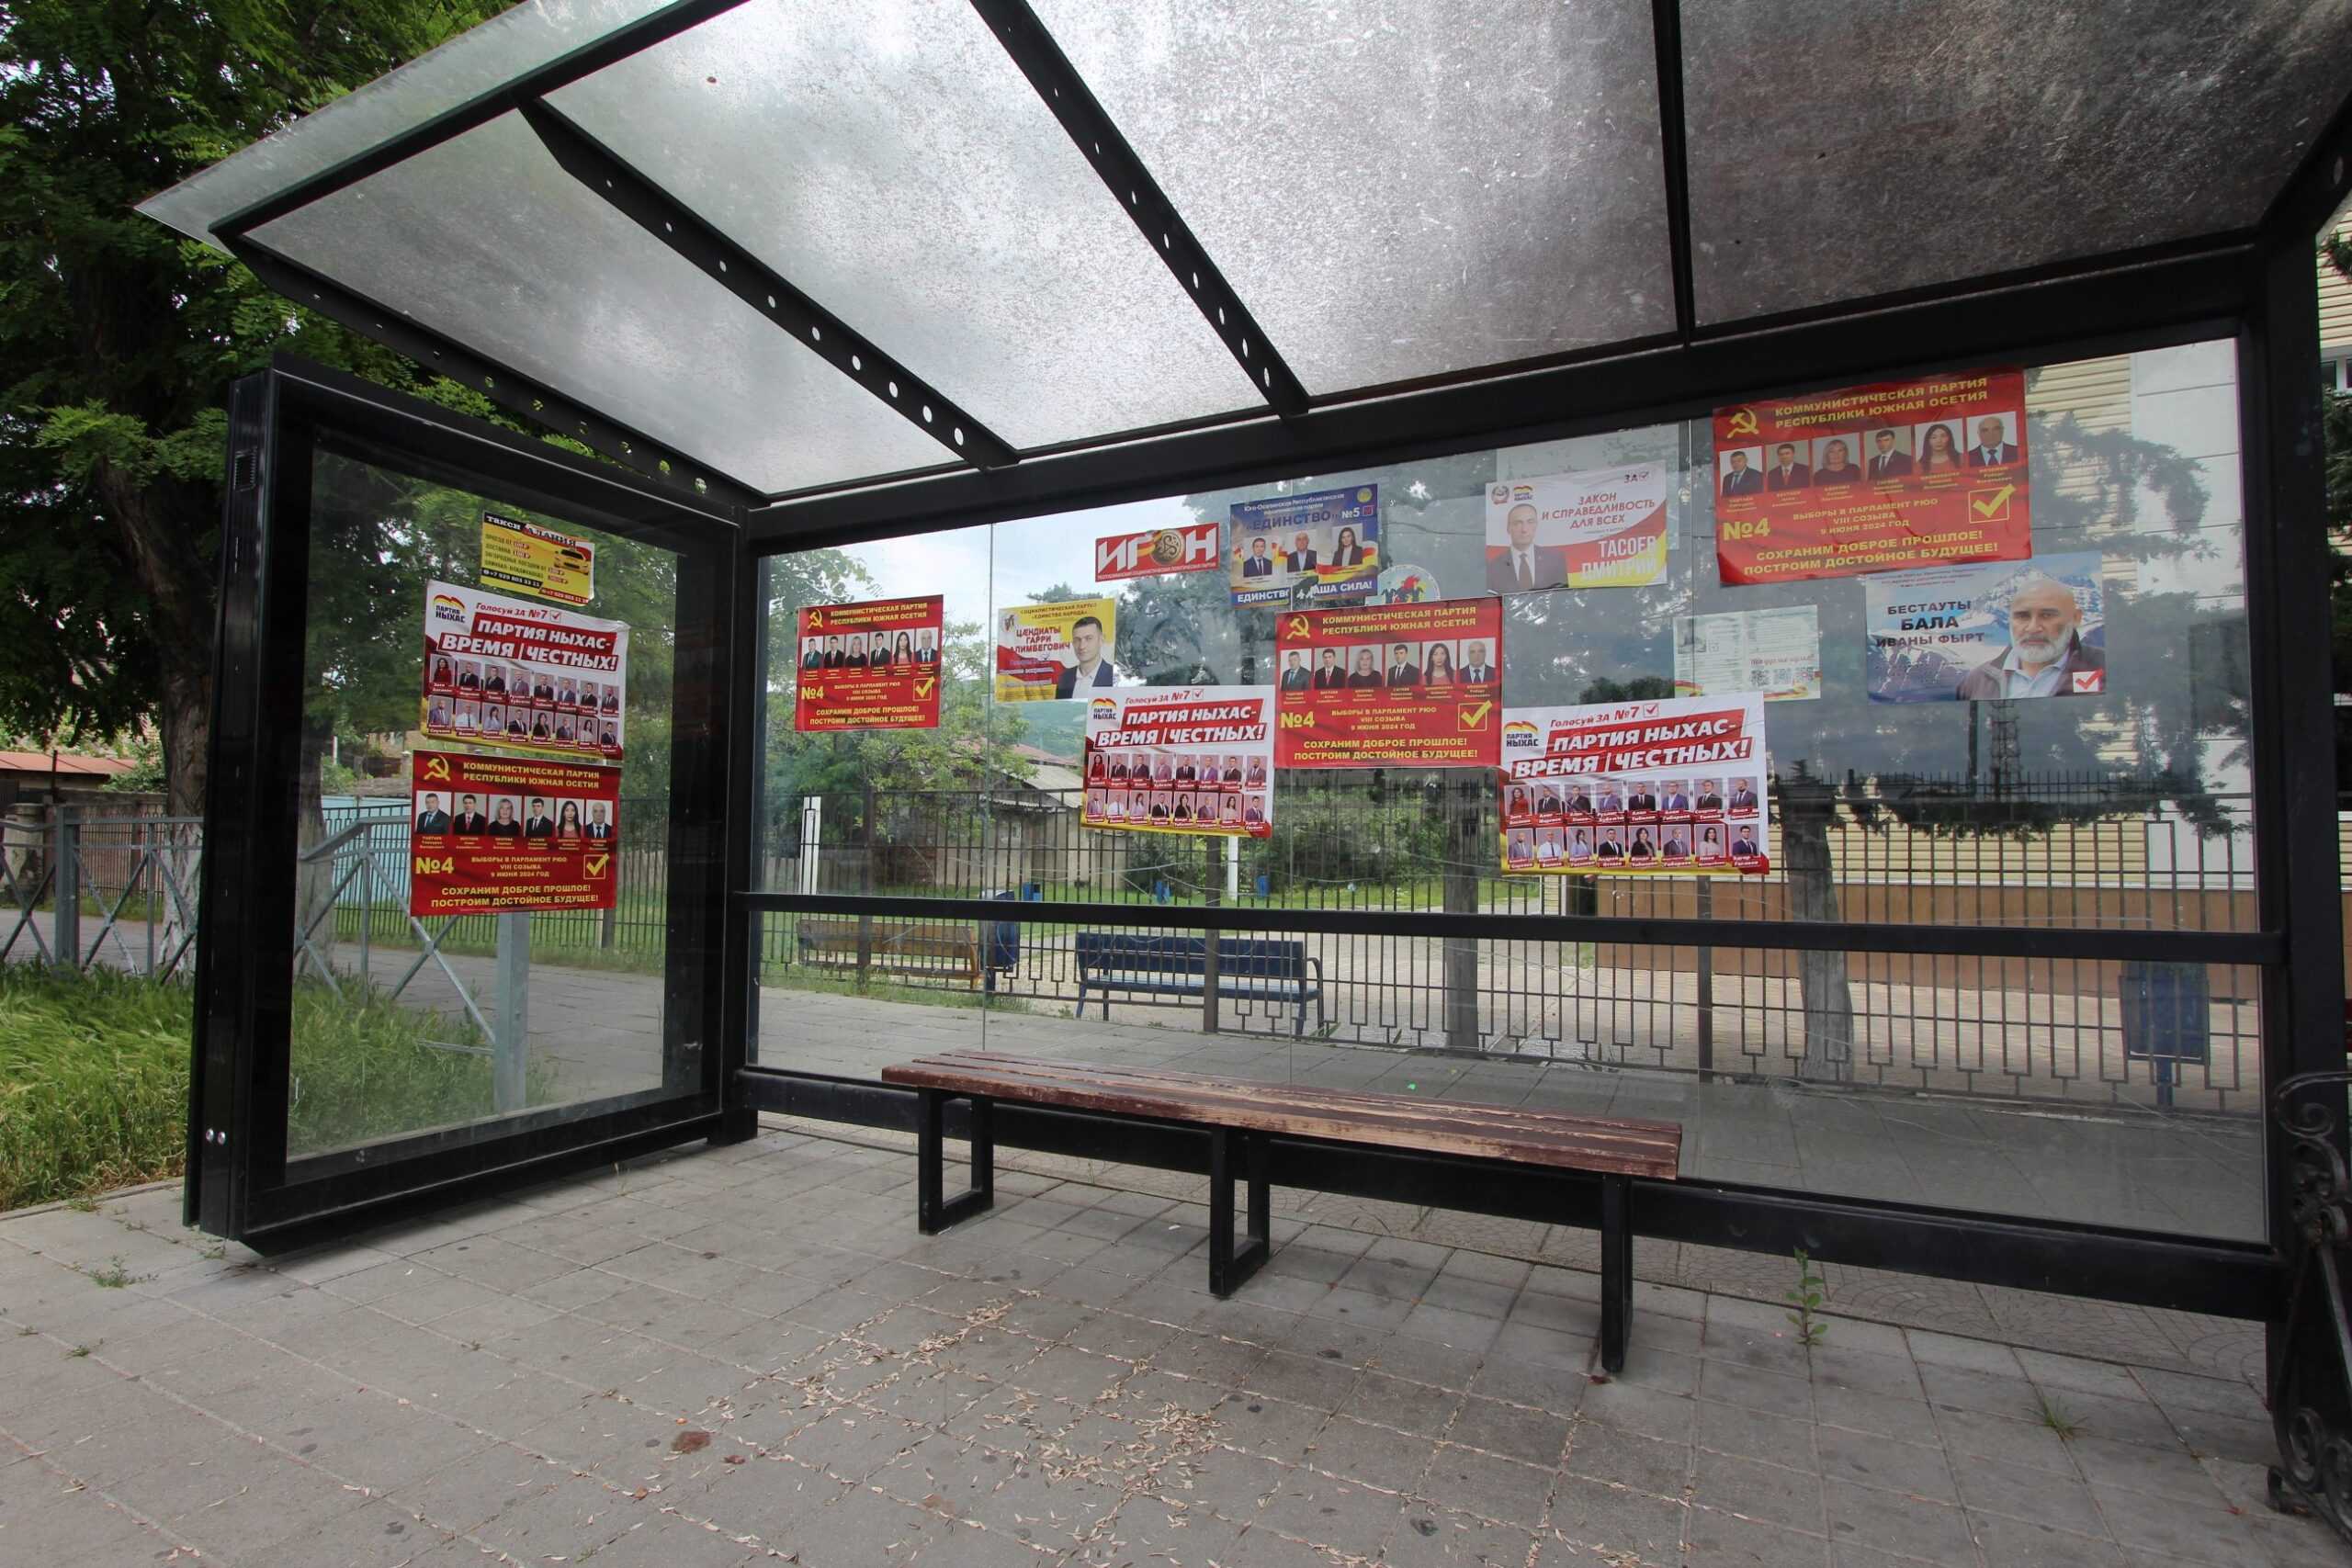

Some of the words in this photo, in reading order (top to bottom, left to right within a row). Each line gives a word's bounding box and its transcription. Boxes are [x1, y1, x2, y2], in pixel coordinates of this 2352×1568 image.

[1775, 388, 1925, 417] КОММУНИСТИЧЕСКАЯ
[1929, 378, 1987, 394] ПАРТИЯ
[1776, 409, 1865, 429] РЕСПУБЛИКИ
[1869, 400, 1925, 415] ЮЖНАЯ
[1929, 391, 1987, 407] ОСЕТИЯ
[1624, 474, 1638, 483] ЗА
[1578, 492, 1617, 505] ЗАКОН
[1341, 508, 1360, 519] №5
[1542, 512, 1550, 520] И
[1552, 500, 1655, 519] СПРАВЕДЛИВОСТЬ
[1849, 501, 1911, 515] ПАРЛАМЕНТ
[1569, 517, 1593, 529] ДЛЯ
[1597, 514, 1625, 525] ВСЕХ
[1889, 520, 1910, 528] ГОД
[1723, 518, 1770, 541] №4
[1757, 545, 1834, 561] СОХРАНИМ
[1838, 539, 1897, 554] ДОБРОЕ
[1903, 530, 1983, 546] ПРОШЛОЕ!
[1744, 558, 1821, 576] ПОСТРОИМ
[1826, 550, 1916, 569] ДОСТОЙНОЕ
[1920, 544, 1998, 559] БУДУЩЕЕ!
[1340, 581, 1373, 592] СИЛА!
[529, 610, 547, 619] №7
[831, 605, 899, 616] КОММУНИСТИЧЕСКАЯ
[1887, 601, 1971, 615] БЕСТАУТЫ
[435, 611, 465, 623] НЫХАС
[831, 616, 871, 625] РЕСПУБЛИКИ
[1323, 610, 1430, 625] КОММУНИСТИЧЕСКАЯ
[1434, 607, 1476, 616] ПАРТИЯ
[1901, 616, 1959, 631] БАЛА
[478, 620, 547, 640] ПАРТИЯ
[548, 632, 610, 649] НЫХАС-
[1323, 624, 1387, 636] РЕСПУБЛИКИ
[1390, 622, 1430, 631] ЮЖНАЯ
[1434, 618, 1476, 627] ОСЕТИЯ
[1026, 636, 1051, 644] ГАРРИ
[1876, 637, 1932, 648] ИВАНЫ
[1938, 633, 1984, 642] ФЫРТ
[442, 635, 514, 657] ВРЕМЯ
[527, 646, 616, 671] ЧЕСТНЫХ!
[801, 686, 823, 700] №4
[1171, 691, 1190, 701] №7
[1126, 711, 1188, 725] ПАРТИЯ
[1191, 706, 1256, 721] НЫХАС-
[1372, 707, 1417, 716] ПАРЛАМЕНТ
[1551, 716, 1594, 728] Голосуй
[1614, 706, 1639, 720] №7
[1280, 712, 1315, 728] №4
[1098, 730, 1159, 746] ВРЕМЯ
[1169, 725, 1264, 743] ЧЕСТНЫХ!
[1554, 730, 1640, 751] ПАРТИЯ
[1644, 719, 1736, 743] НЫХАС-
[1304, 740, 1360, 749] СОХРАНИМ
[1363, 739, 1406, 749] ДОБРОЕ
[1409, 738, 1467, 746] ПРОШЛОЕ!
[1295, 752, 1350, 761] ПОСТРОИМ
[1352, 750, 1419, 760] ДОСТОЙНОЕ
[1422, 750, 1477, 759] БУДУЩЕЕ!
[1516, 756, 1600, 777] ВРЕМЯ
[1616, 739, 1747, 770] ЧЕСТНЫХ!
[463, 762, 563, 775] КОММУНИСТИЧЕСКАЯ
[567, 771, 599, 779] ПАРТИЯ
[463, 773, 526, 784] РЕСПУБЛИКИ
[529, 778, 563, 786] ЮЖНАЯ
[416, 857, 454, 874] №4
[442, 886, 499, 895] СОХРАНИМ
[502, 886, 540, 895] ДОБРОЕ
[432, 898, 489, 908] ПОСТРОИМ
[492, 897, 552, 907] ДОСТОЙНОЕ
